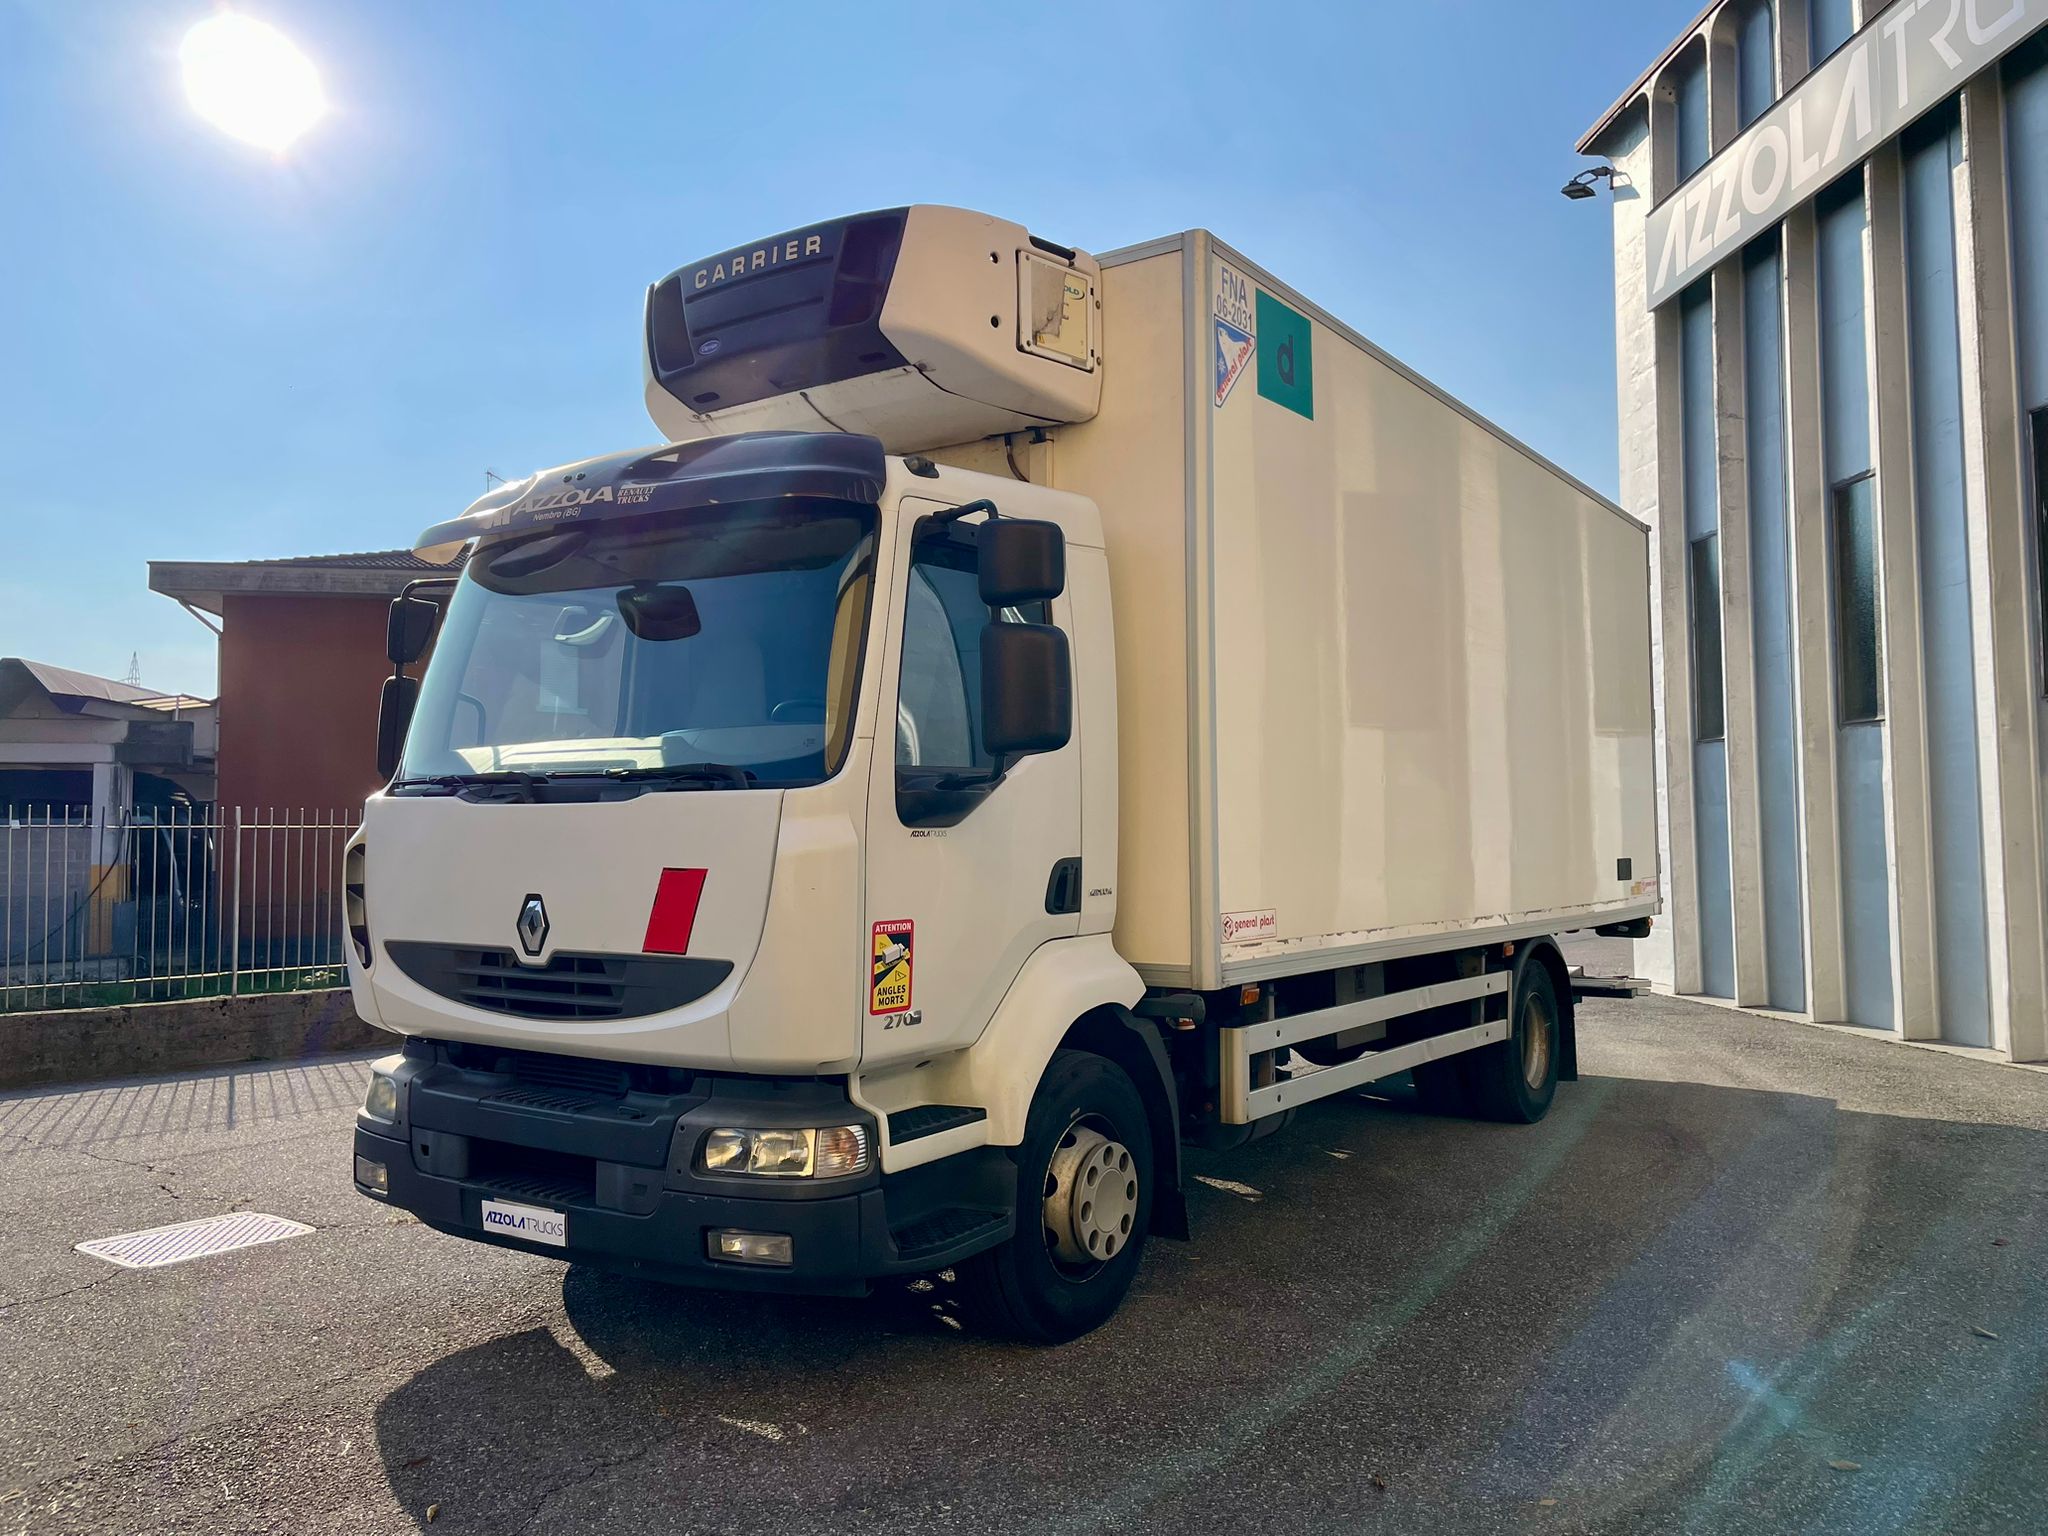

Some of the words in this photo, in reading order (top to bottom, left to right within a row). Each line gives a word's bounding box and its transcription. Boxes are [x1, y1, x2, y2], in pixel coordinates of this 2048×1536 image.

[695, 235, 822, 289] CARRIER
[1221, 266, 1248, 309] FNA
[1216, 294, 1252, 332] 06-2031
[1277, 333, 1294, 387] d
[617, 486, 656, 497] RENAULT
[513, 486, 613, 516] AZZOLA
[617, 495, 650, 505] TRUCKS
[533, 511, 562, 522] Nembro
[875, 922, 912, 933] ATTENTION
[1235, 916, 1258, 932] general
[877, 984, 906, 997] ANGLES
[878, 995, 905, 1007] MORTS
[883, 1012, 914, 1030] 270
